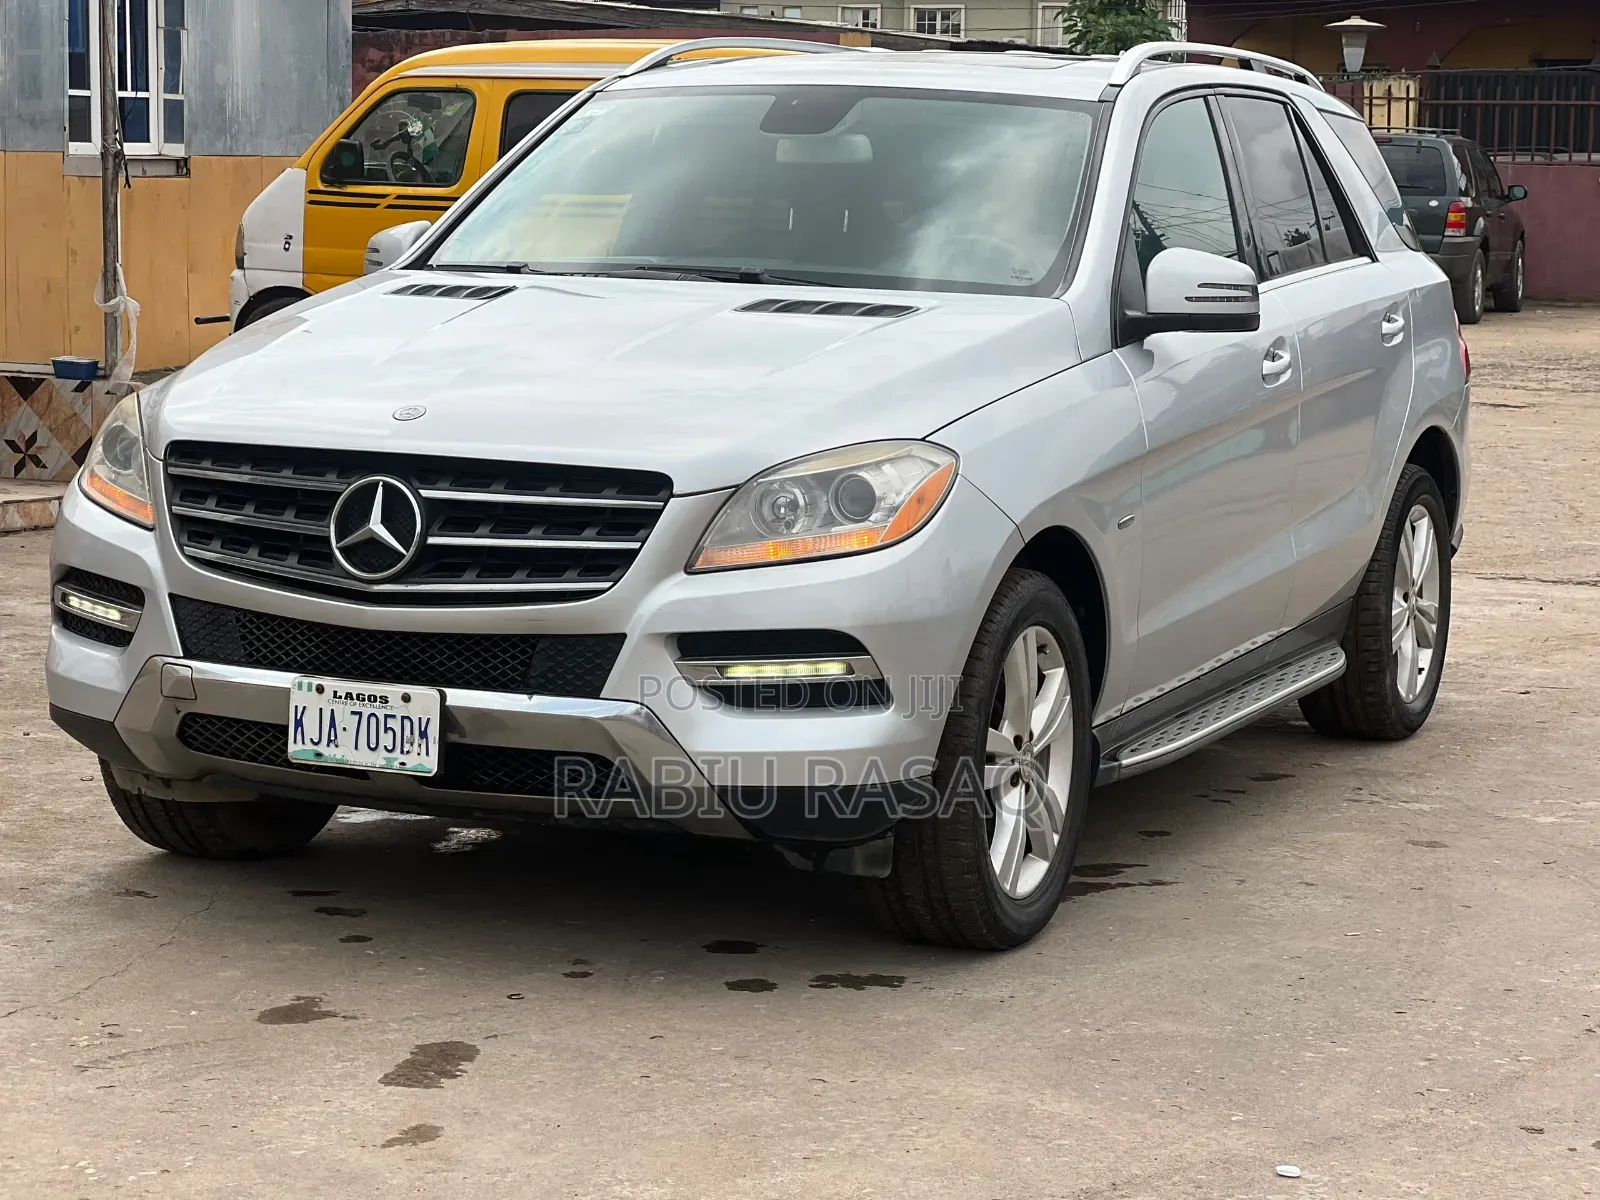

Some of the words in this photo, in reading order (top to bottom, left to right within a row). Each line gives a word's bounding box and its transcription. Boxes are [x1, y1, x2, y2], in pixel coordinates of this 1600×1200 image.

[327, 698, 349, 706] CENTRE
[358, 702, 394, 711] EXCELLENCE
[332, 690, 390, 705] LAGOS
